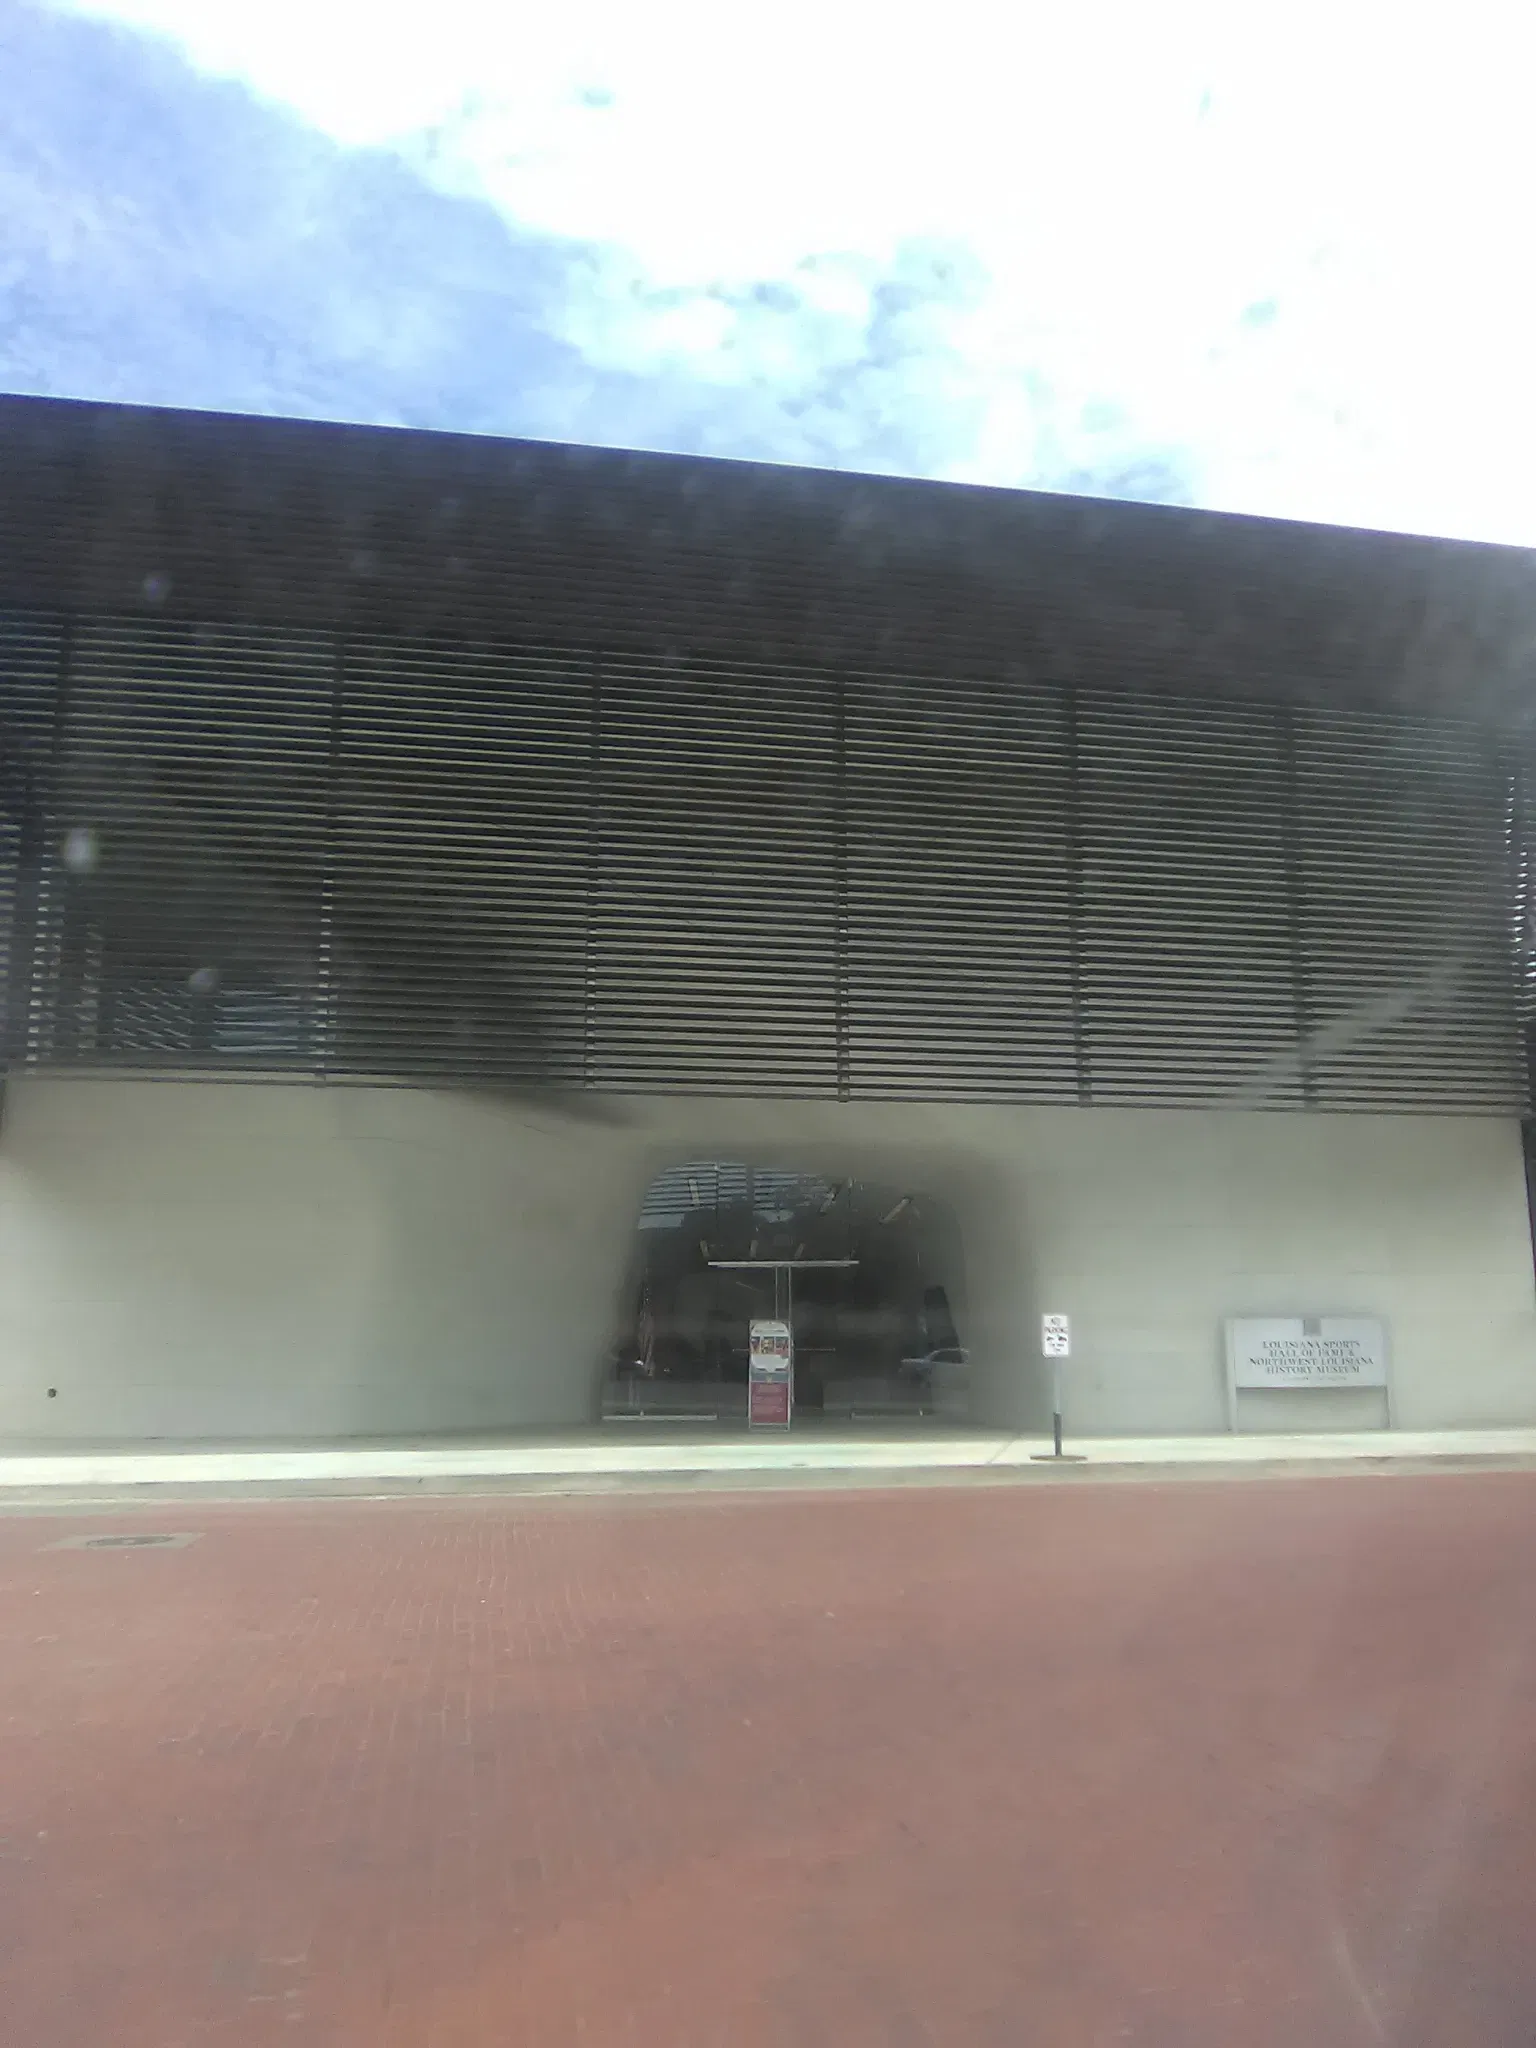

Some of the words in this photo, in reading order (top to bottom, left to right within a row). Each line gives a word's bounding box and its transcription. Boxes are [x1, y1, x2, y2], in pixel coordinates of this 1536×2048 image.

[1263, 1340, 1320, 1349] LOUISIANA
[1323, 1340, 1360, 1349] SPORTS
[1270, 1349, 1297, 1357] HALL
[1302, 1349, 1314, 1357] OF
[1318, 1349, 1344, 1357] FAME
[1249, 1357, 1316, 1366] NORTHWEST
[1321, 1357, 1374, 1365] LOUISIANA
[1267, 1366, 1312, 1374] HISTORY
[1316, 1365, 1360, 1373] MUSEUM
